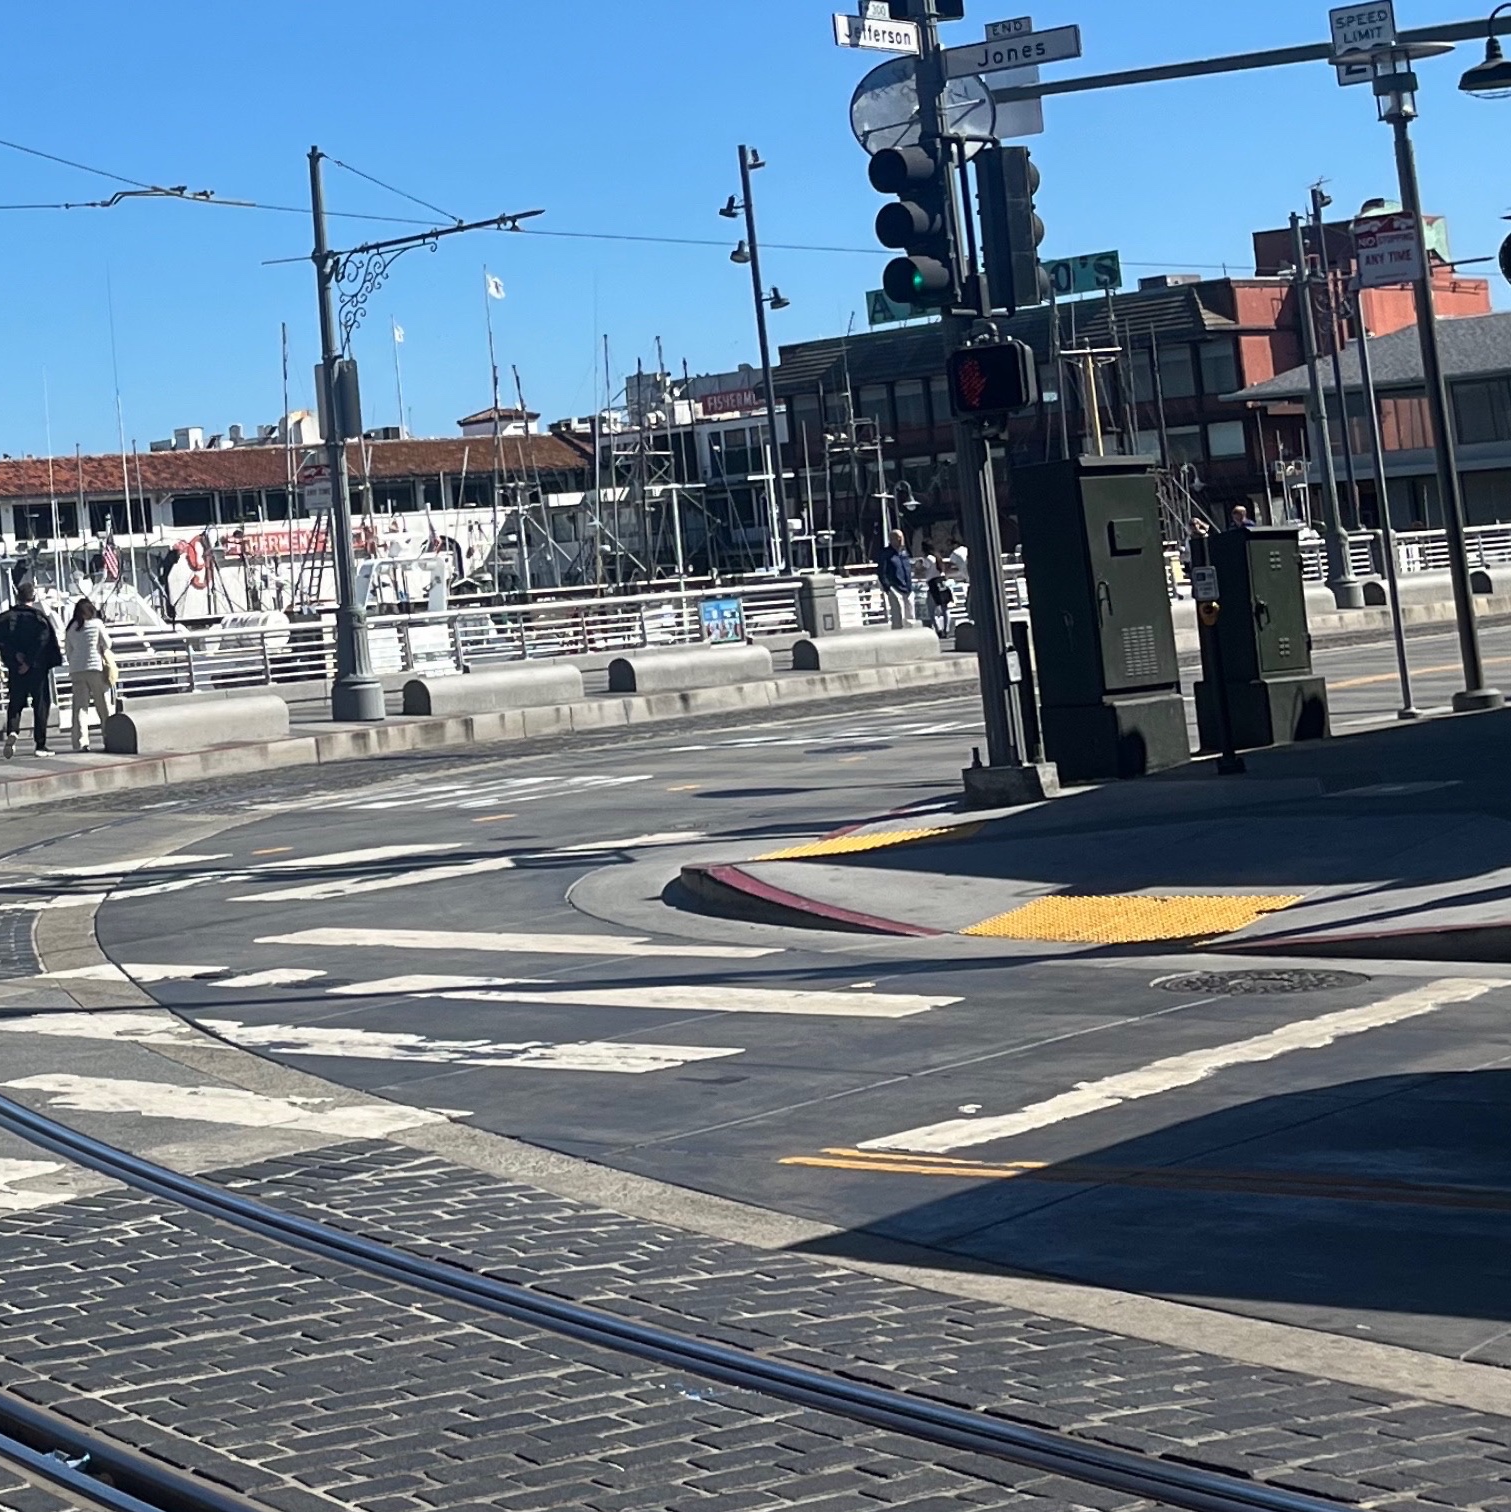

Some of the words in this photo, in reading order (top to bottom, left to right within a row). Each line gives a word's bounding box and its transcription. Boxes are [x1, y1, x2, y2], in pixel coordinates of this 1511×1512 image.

[992, 20, 1023, 37] END
[1335, 9, 1388, 29] SPEED
[844, 22, 912, 46] Jefferson
[1343, 26, 1383, 44] LIMIT
[977, 40, 1046, 68] Jones
[707, 391, 760, 411] FISHERM
